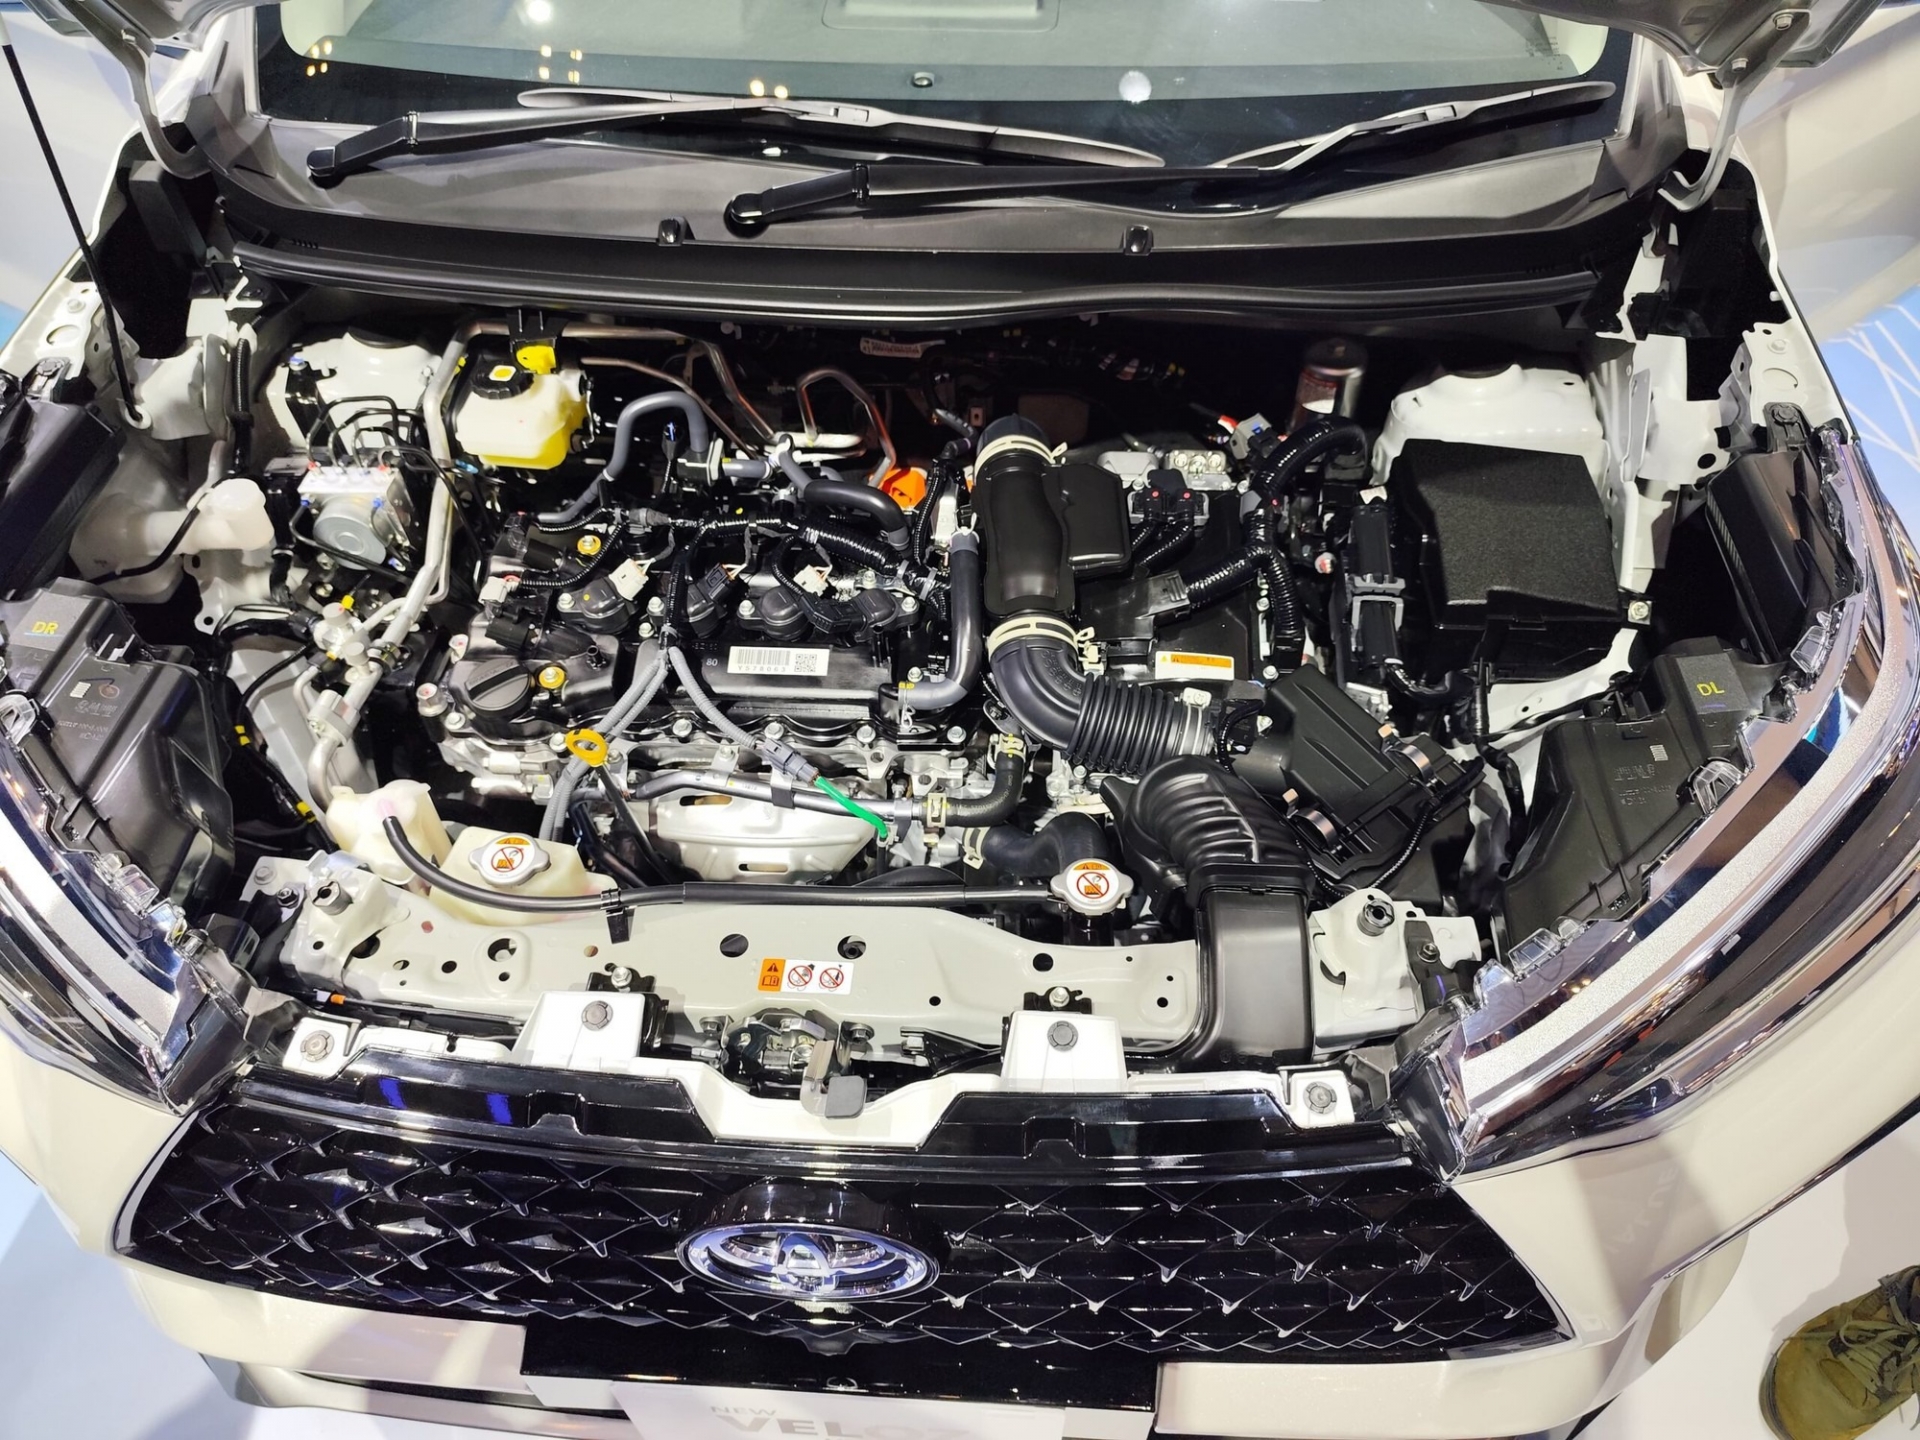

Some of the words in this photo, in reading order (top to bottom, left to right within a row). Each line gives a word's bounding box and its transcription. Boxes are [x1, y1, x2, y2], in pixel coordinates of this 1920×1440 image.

[32, 621, 59, 635] DR
[706, 657, 718, 666] 80
[1697, 682, 1725, 696] DL
[710, 1406, 776, 1416] NEW
